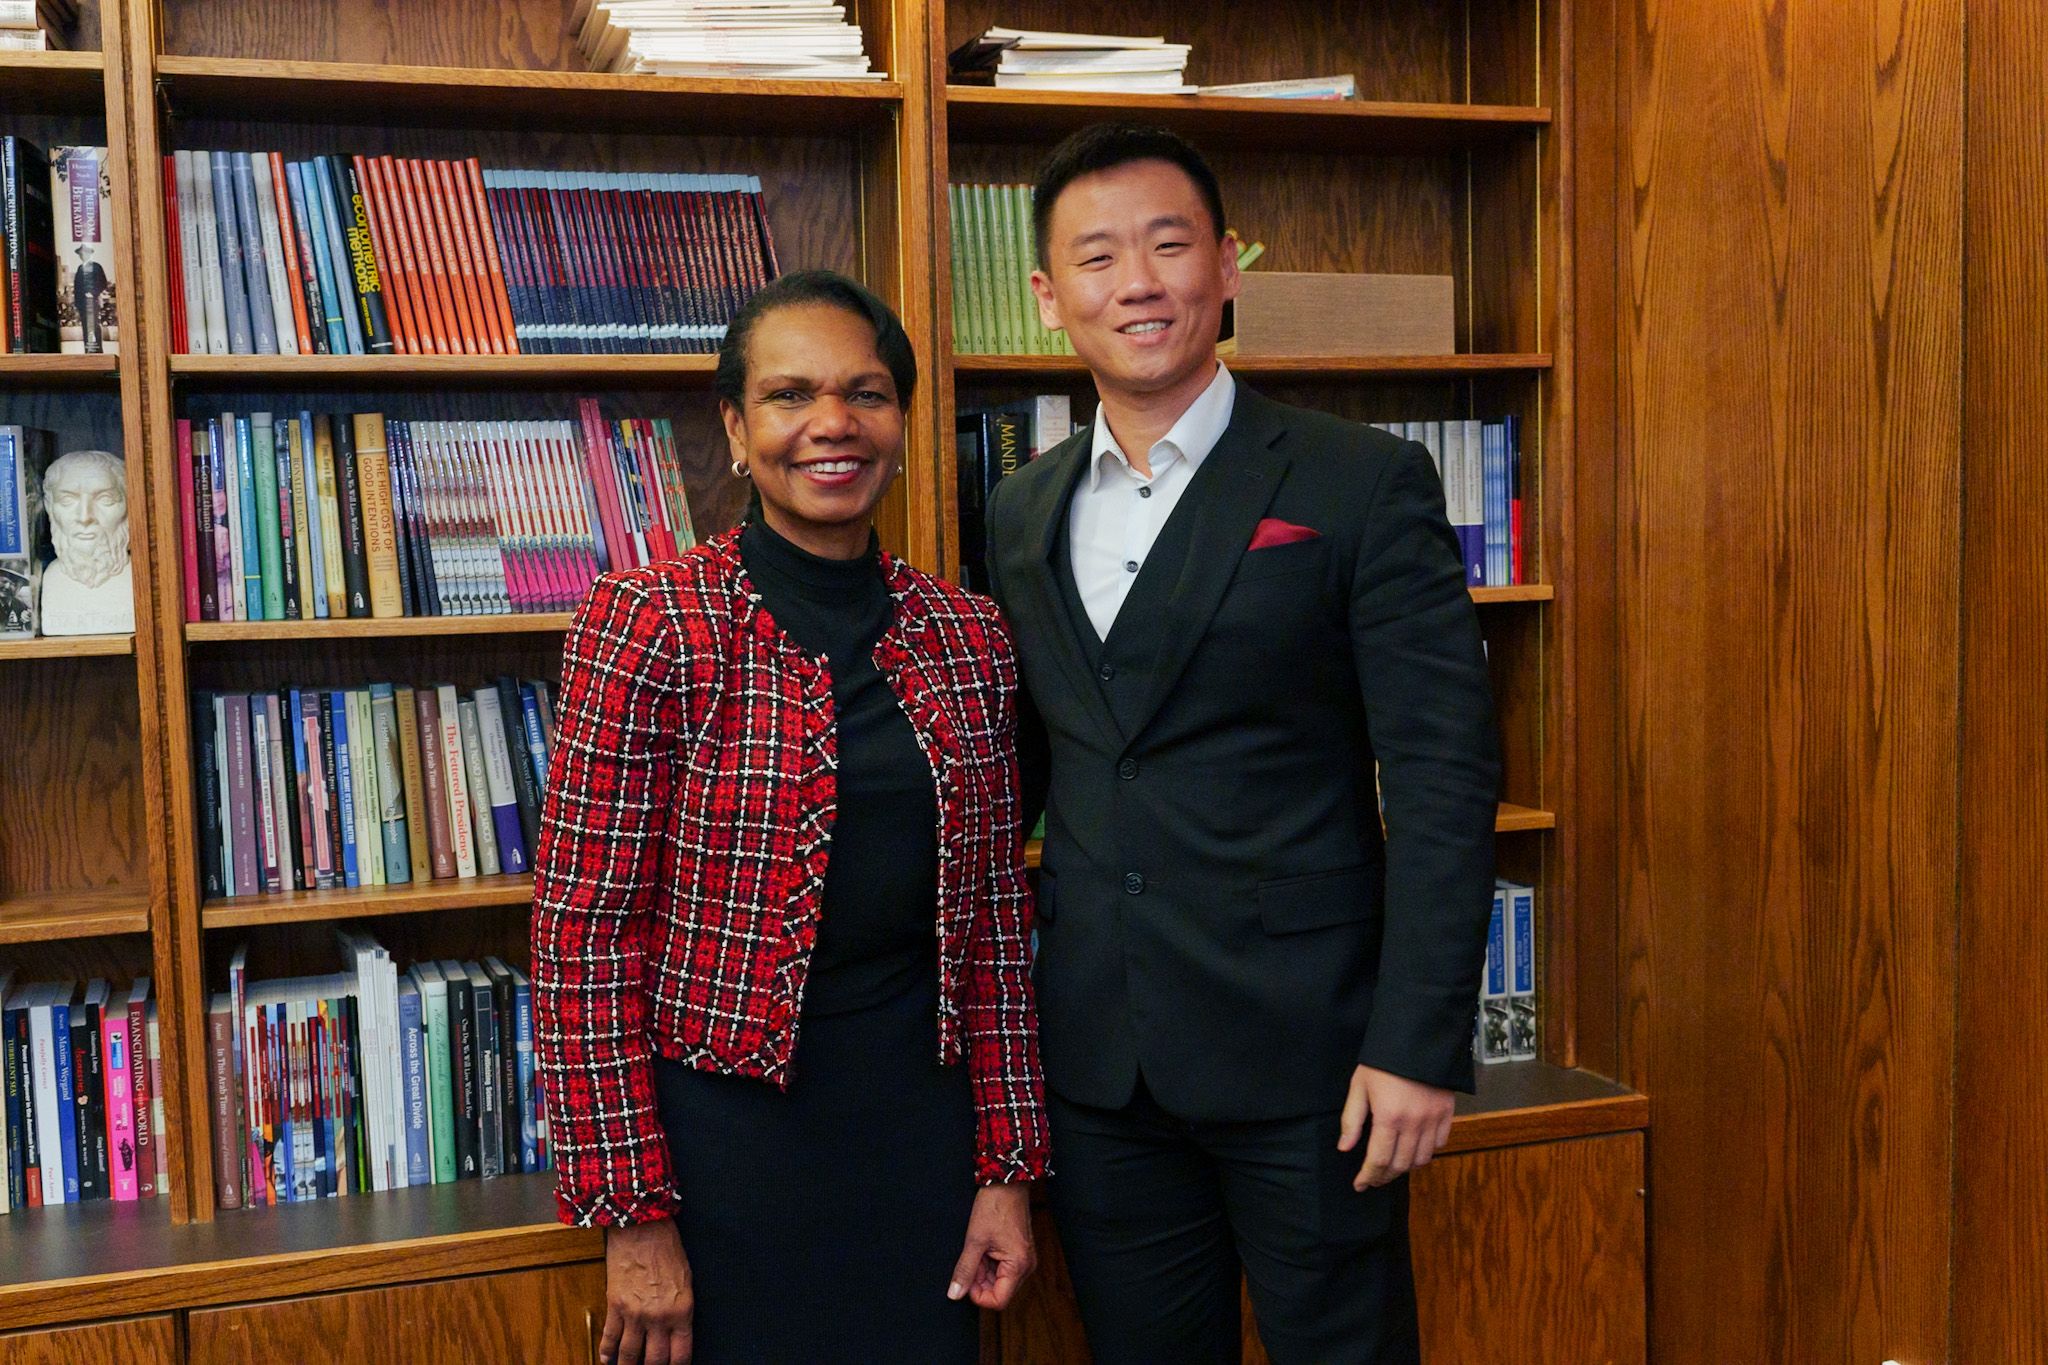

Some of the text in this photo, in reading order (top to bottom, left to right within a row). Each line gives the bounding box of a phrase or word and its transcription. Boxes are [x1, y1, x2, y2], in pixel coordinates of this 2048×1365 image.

[5, 141, 15, 167] Sowell
[6, 177, 18, 255] DISCRIMINATION
[72, 186, 84, 238] BETRAYED
[85, 187, 97, 236] FREEDOM
[366, 423, 375, 447] COGAN
[345, 452, 353, 466] One
[345, 466, 355, 478] Day
[347, 479, 355, 488] We
[201, 464, 213, 532] Corn Ethanol
[292, 457, 305, 532] RONALD REAGAN
[348, 490, 357, 502] Will
[362, 457, 380, 553] GOOD INTENTIONS
[376, 456, 393, 553] THE HIGH COST OF
[349, 503, 358, 516] Live
[350, 516, 360, 541] Without
[424, 724, 431, 733] In
[527, 708, 537, 731] ENERGY
[381, 727, 390, 749] Hoffer
[425, 734, 433, 750] This
[446, 724, 457, 746] The
[339, 744, 347, 753] YOU
[341, 754, 349, 766] HAVE
[426, 751, 435, 769] Arab
[326, 751, 335, 774] Spending
[449, 750, 462, 796] Fettered
[521, 758, 531, 780] Secret
[404, 718, 422, 835] THE NUCLEAR ENTERPRISE
[428, 770, 437, 789] Time
[206, 778, 215, 800] Secret
[524, 780, 535, 807] Journey
[206, 800, 217, 830] Journey
[344, 804, 353, 825] GETTING
[454, 799, 470, 861] Presidency
[521, 1004, 529, 1028] ENERGY
[215, 1022, 223, 1040] Ajami
[408, 1027, 419, 1058] Across
[461, 1031, 470, 1043] Day
[7, 1038, 16, 1079] TURBULENT
[131, 1011, 146, 1091] EMANCIPATING
[217, 1048, 225, 1056] In
[463, 1045, 470, 1053] We
[463, 1054, 471, 1067] Will
[58, 1035, 70, 1100] Maxime Weygand
[218, 1057, 226, 1074] This
[410, 1060, 419, 1074] the
[464, 1068, 472, 1080] Live
[483, 1049, 492, 1085] Politicizing
[219, 1075, 228, 1094] Arab
[411, 1075, 421, 1100] Great
[464, 1081, 473, 1105] Without
[506, 1058, 514, 1105] EXPERIENCE
[21, 1044, 29, 1061] Power
[28, 1145, 36, 1163] Future
[220, 1095, 229, 1115] Time
[412, 1101, 423, 1129] Divide
[137, 1106, 148, 1145] WORLD
